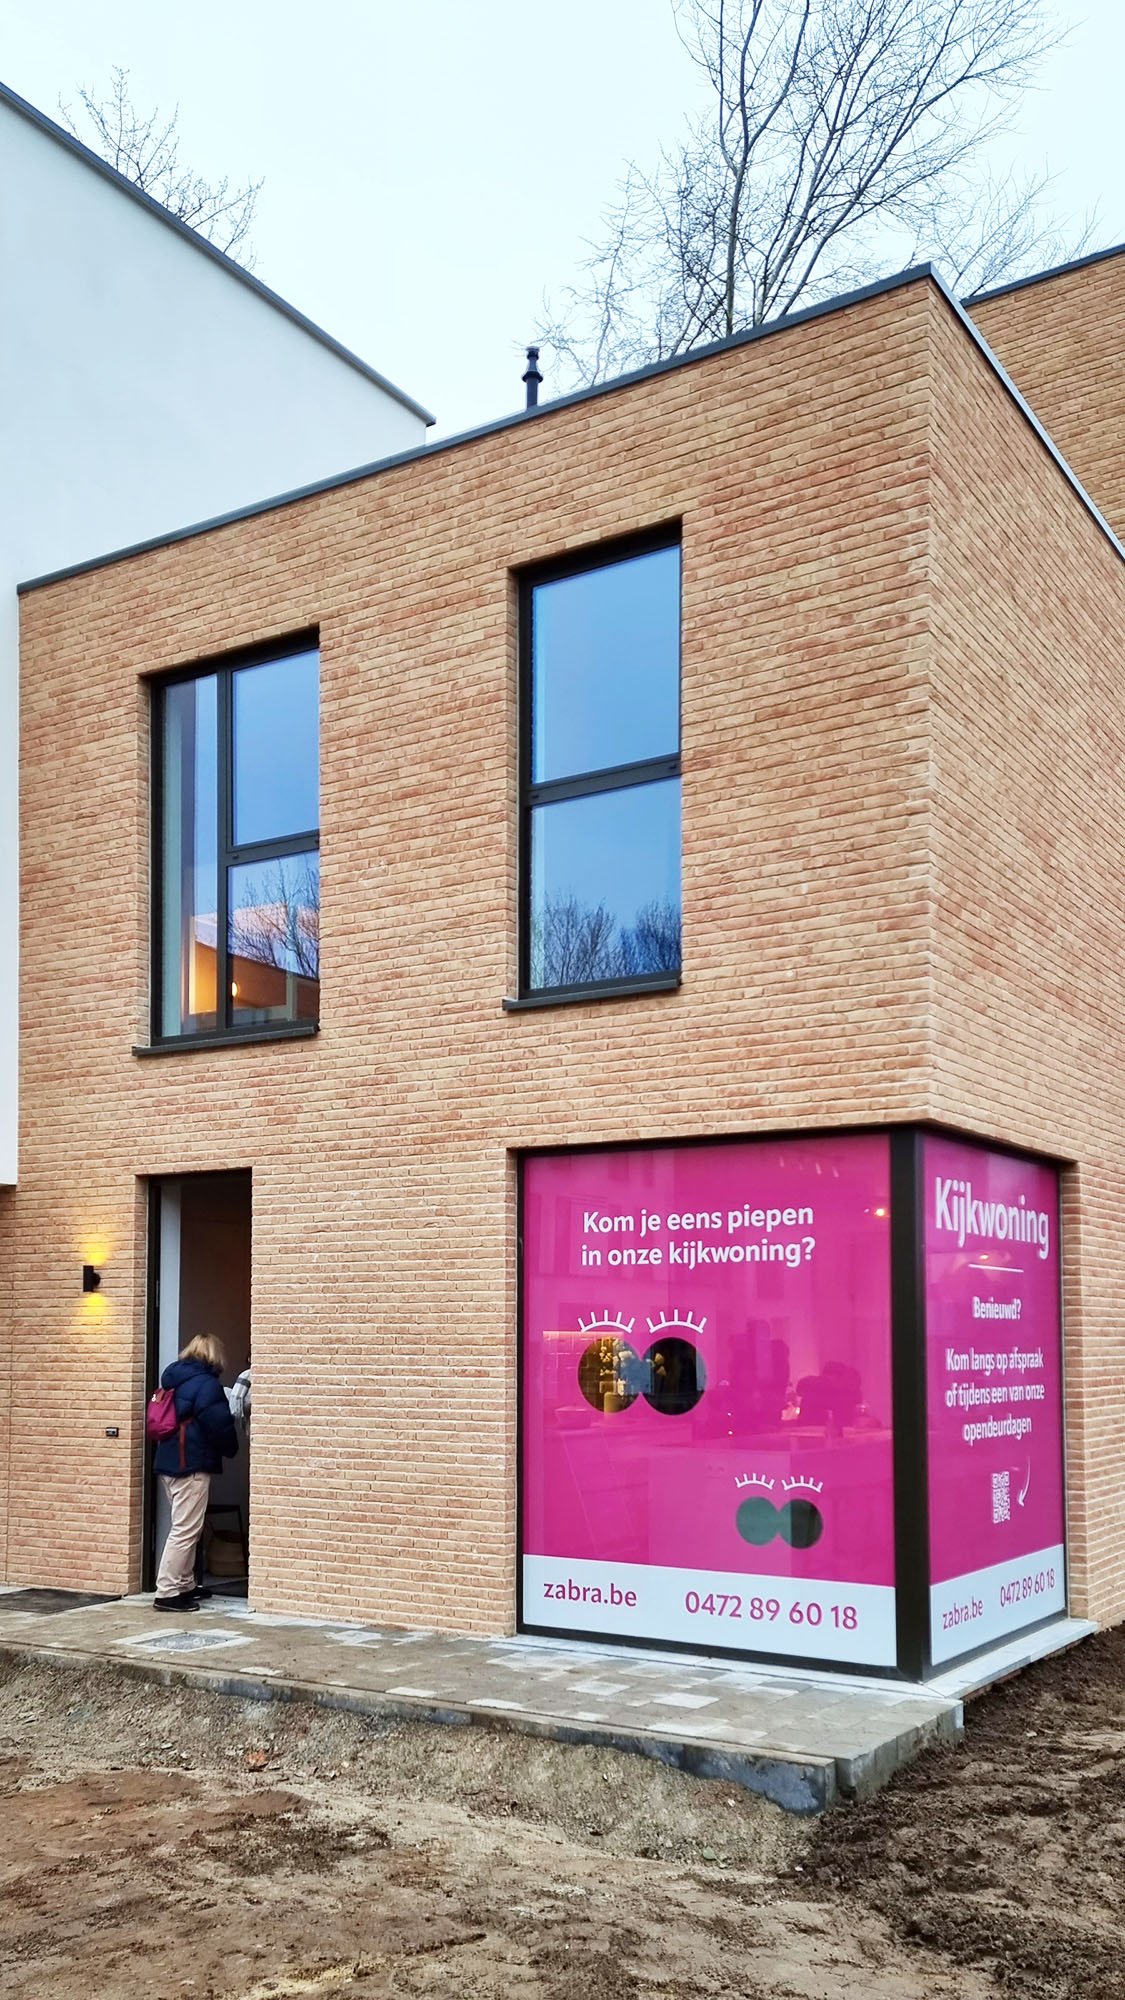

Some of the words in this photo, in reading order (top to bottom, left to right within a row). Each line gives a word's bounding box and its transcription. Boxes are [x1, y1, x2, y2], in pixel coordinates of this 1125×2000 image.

[583, 1211, 635, 1233] Kom
[641, 1209, 661, 1238] je
[667, 1211, 722, 1231] eens
[728, 1203, 814, 1234] piepen
[935, 1176, 1049, 1260] Kijkwoning
[581, 1244, 601, 1266] in
[608, 1247, 663, 1265] onze
[669, 1236, 816, 1270] kijkwoning?
[973, 1296, 1022, 1320] Benieuwd?
[946, 1348, 969, 1371] Kom
[971, 1346, 995, 1376] langs
[996, 1351, 1007, 1374] op
[1009, 1346, 1044, 1374] afspraak
[945, 1383, 958, 1408] of
[959, 1382, 990, 1412] tijdens
[991, 1387, 1008, 1402] een
[1010, 1386, 1025, 1401] van
[1026, 1384, 1045, 1400] onze
[963, 1413, 1032, 1446] opendeurdagen
[543, 1578, 637, 1607] zabra.be
[1000, 1580, 1021, 1608] 0472
[1022, 1576, 1033, 1599] 89
[1034, 1571, 1045, 1595] 60
[1046, 1568, 1055, 1590] 18
[685, 1591, 742, 1618] 0472
[750, 1597, 780, 1622] 89
[789, 1602, 822, 1627] 60
[831, 1605, 858, 1630] 18
[942, 1596, 984, 1630] zabra.be
